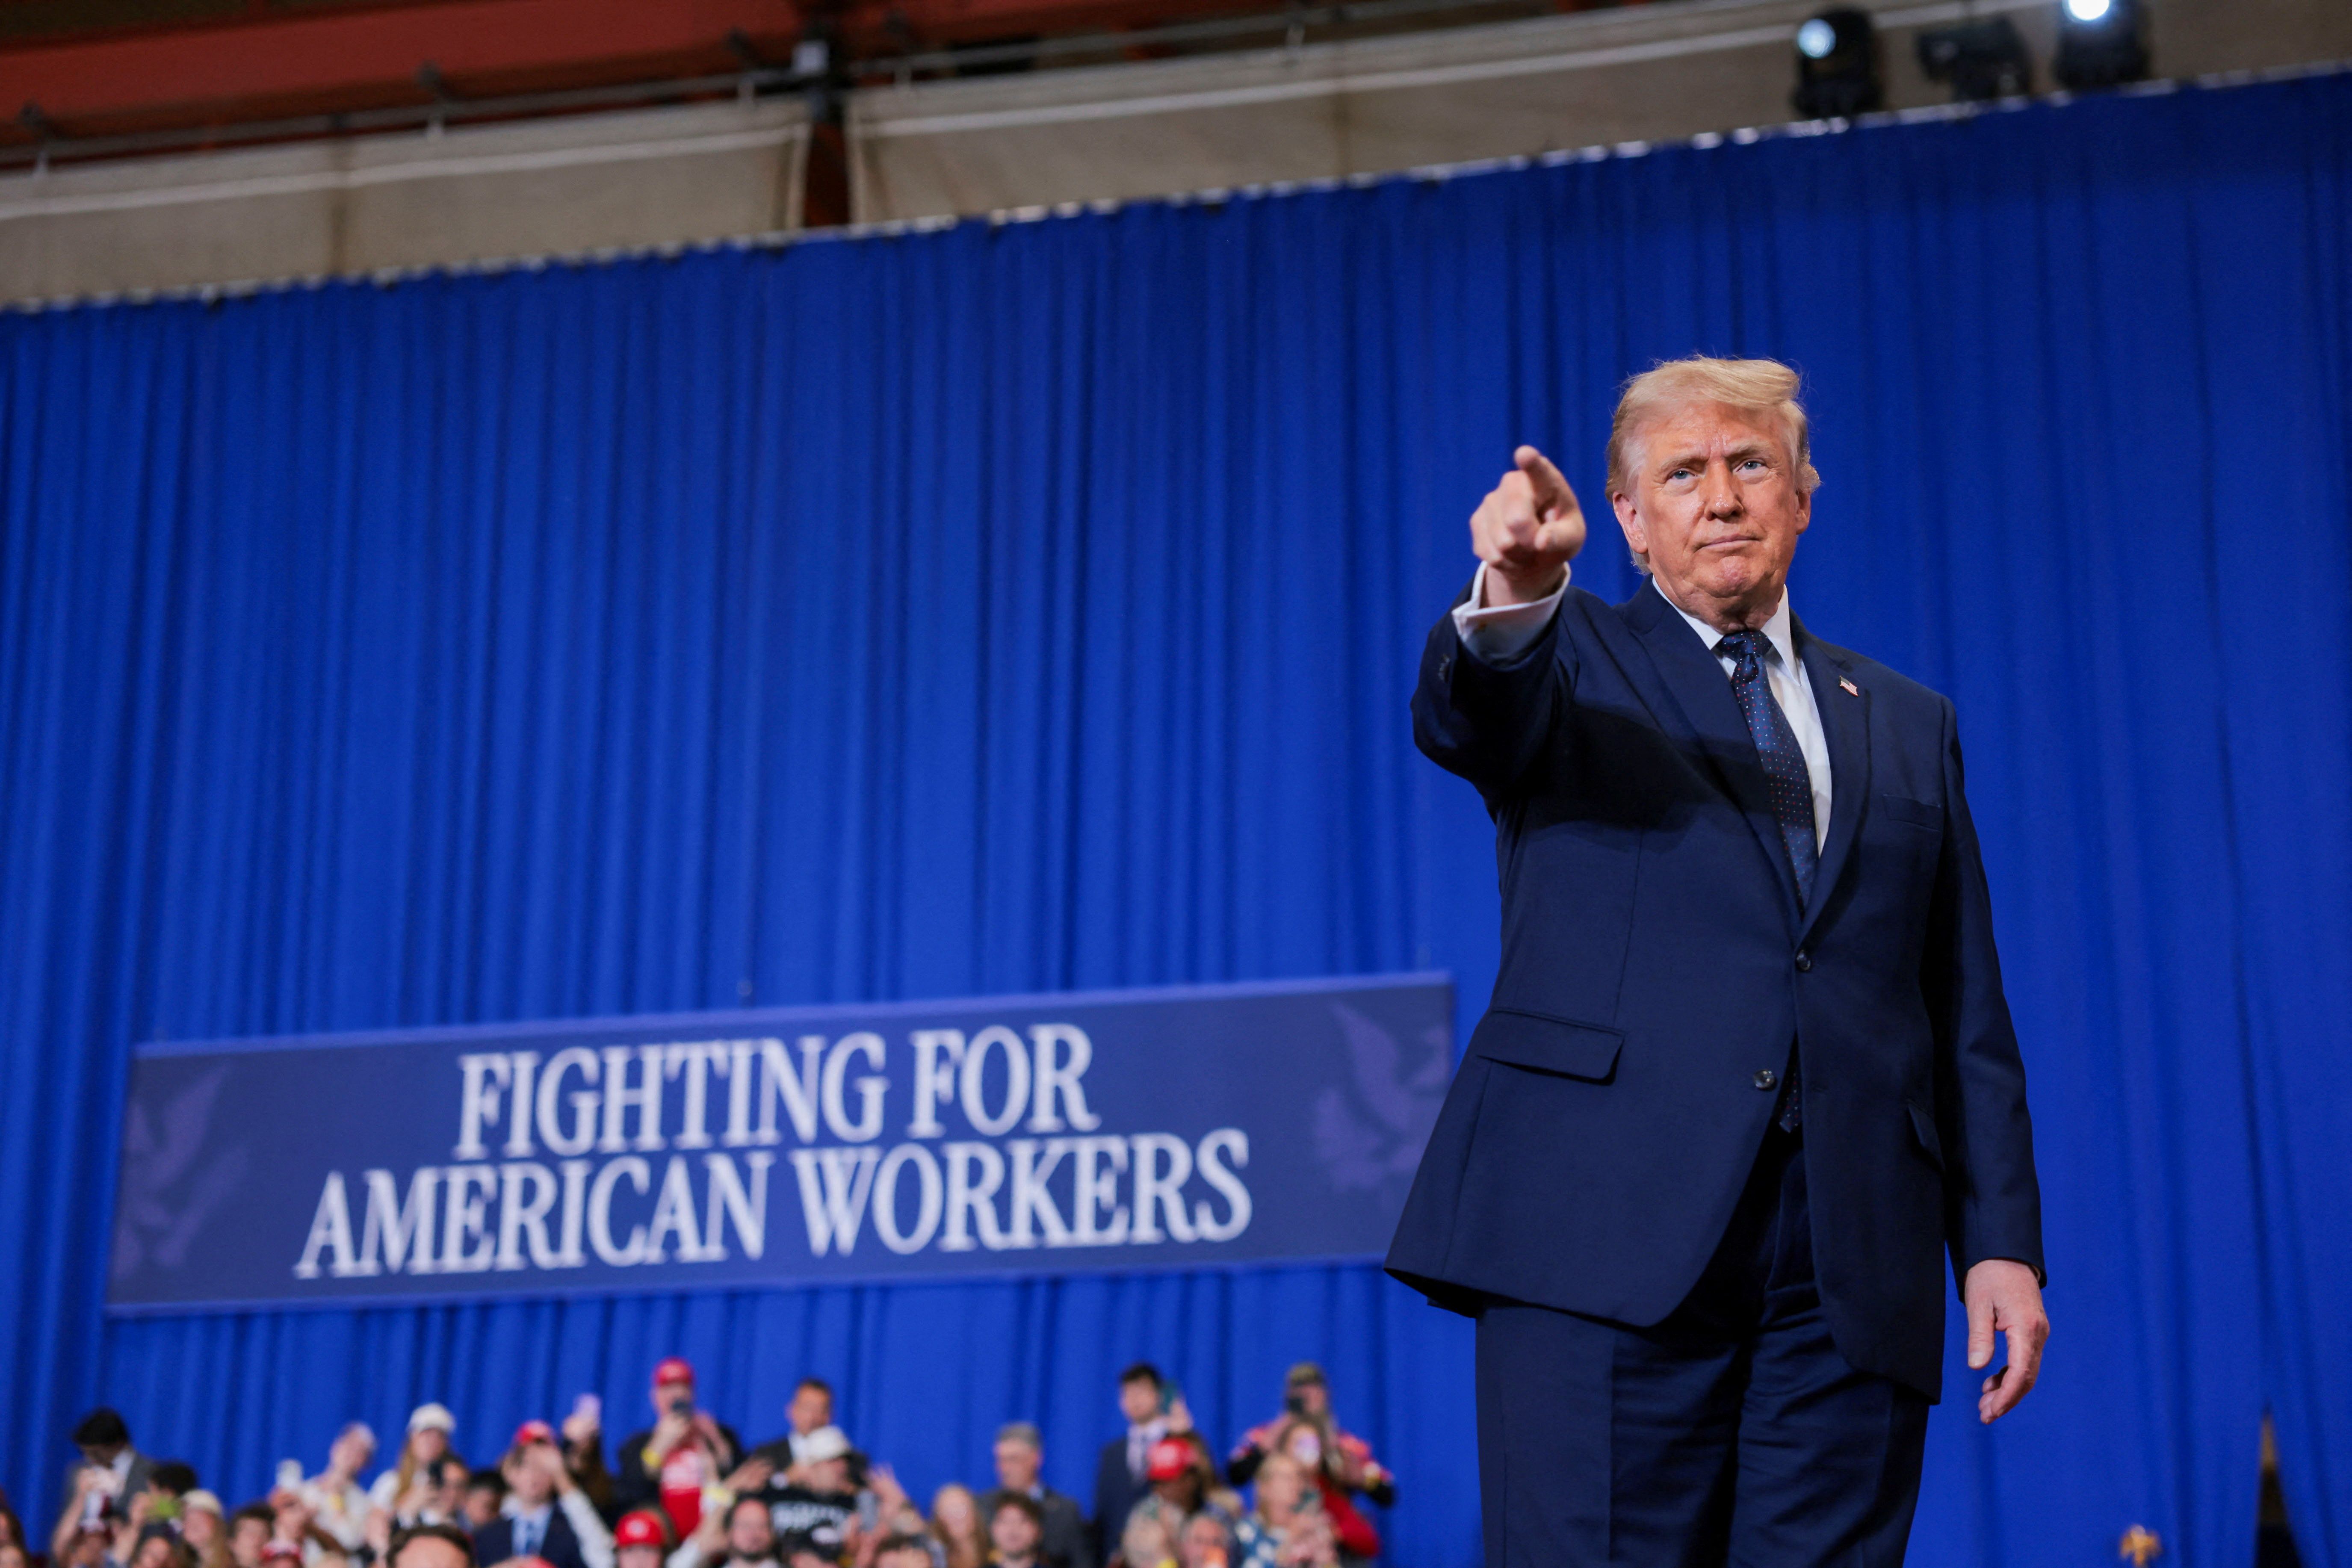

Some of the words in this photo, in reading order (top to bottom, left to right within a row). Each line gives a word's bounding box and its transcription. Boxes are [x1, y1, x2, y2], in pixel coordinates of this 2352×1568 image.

[456, 1033, 886, 1159] FIGHTING
[910, 1024, 1098, 1138] FOR
[296, 1152, 772, 1278] AMERICAN
[792, 1129, 1251, 1255] WORKERS
